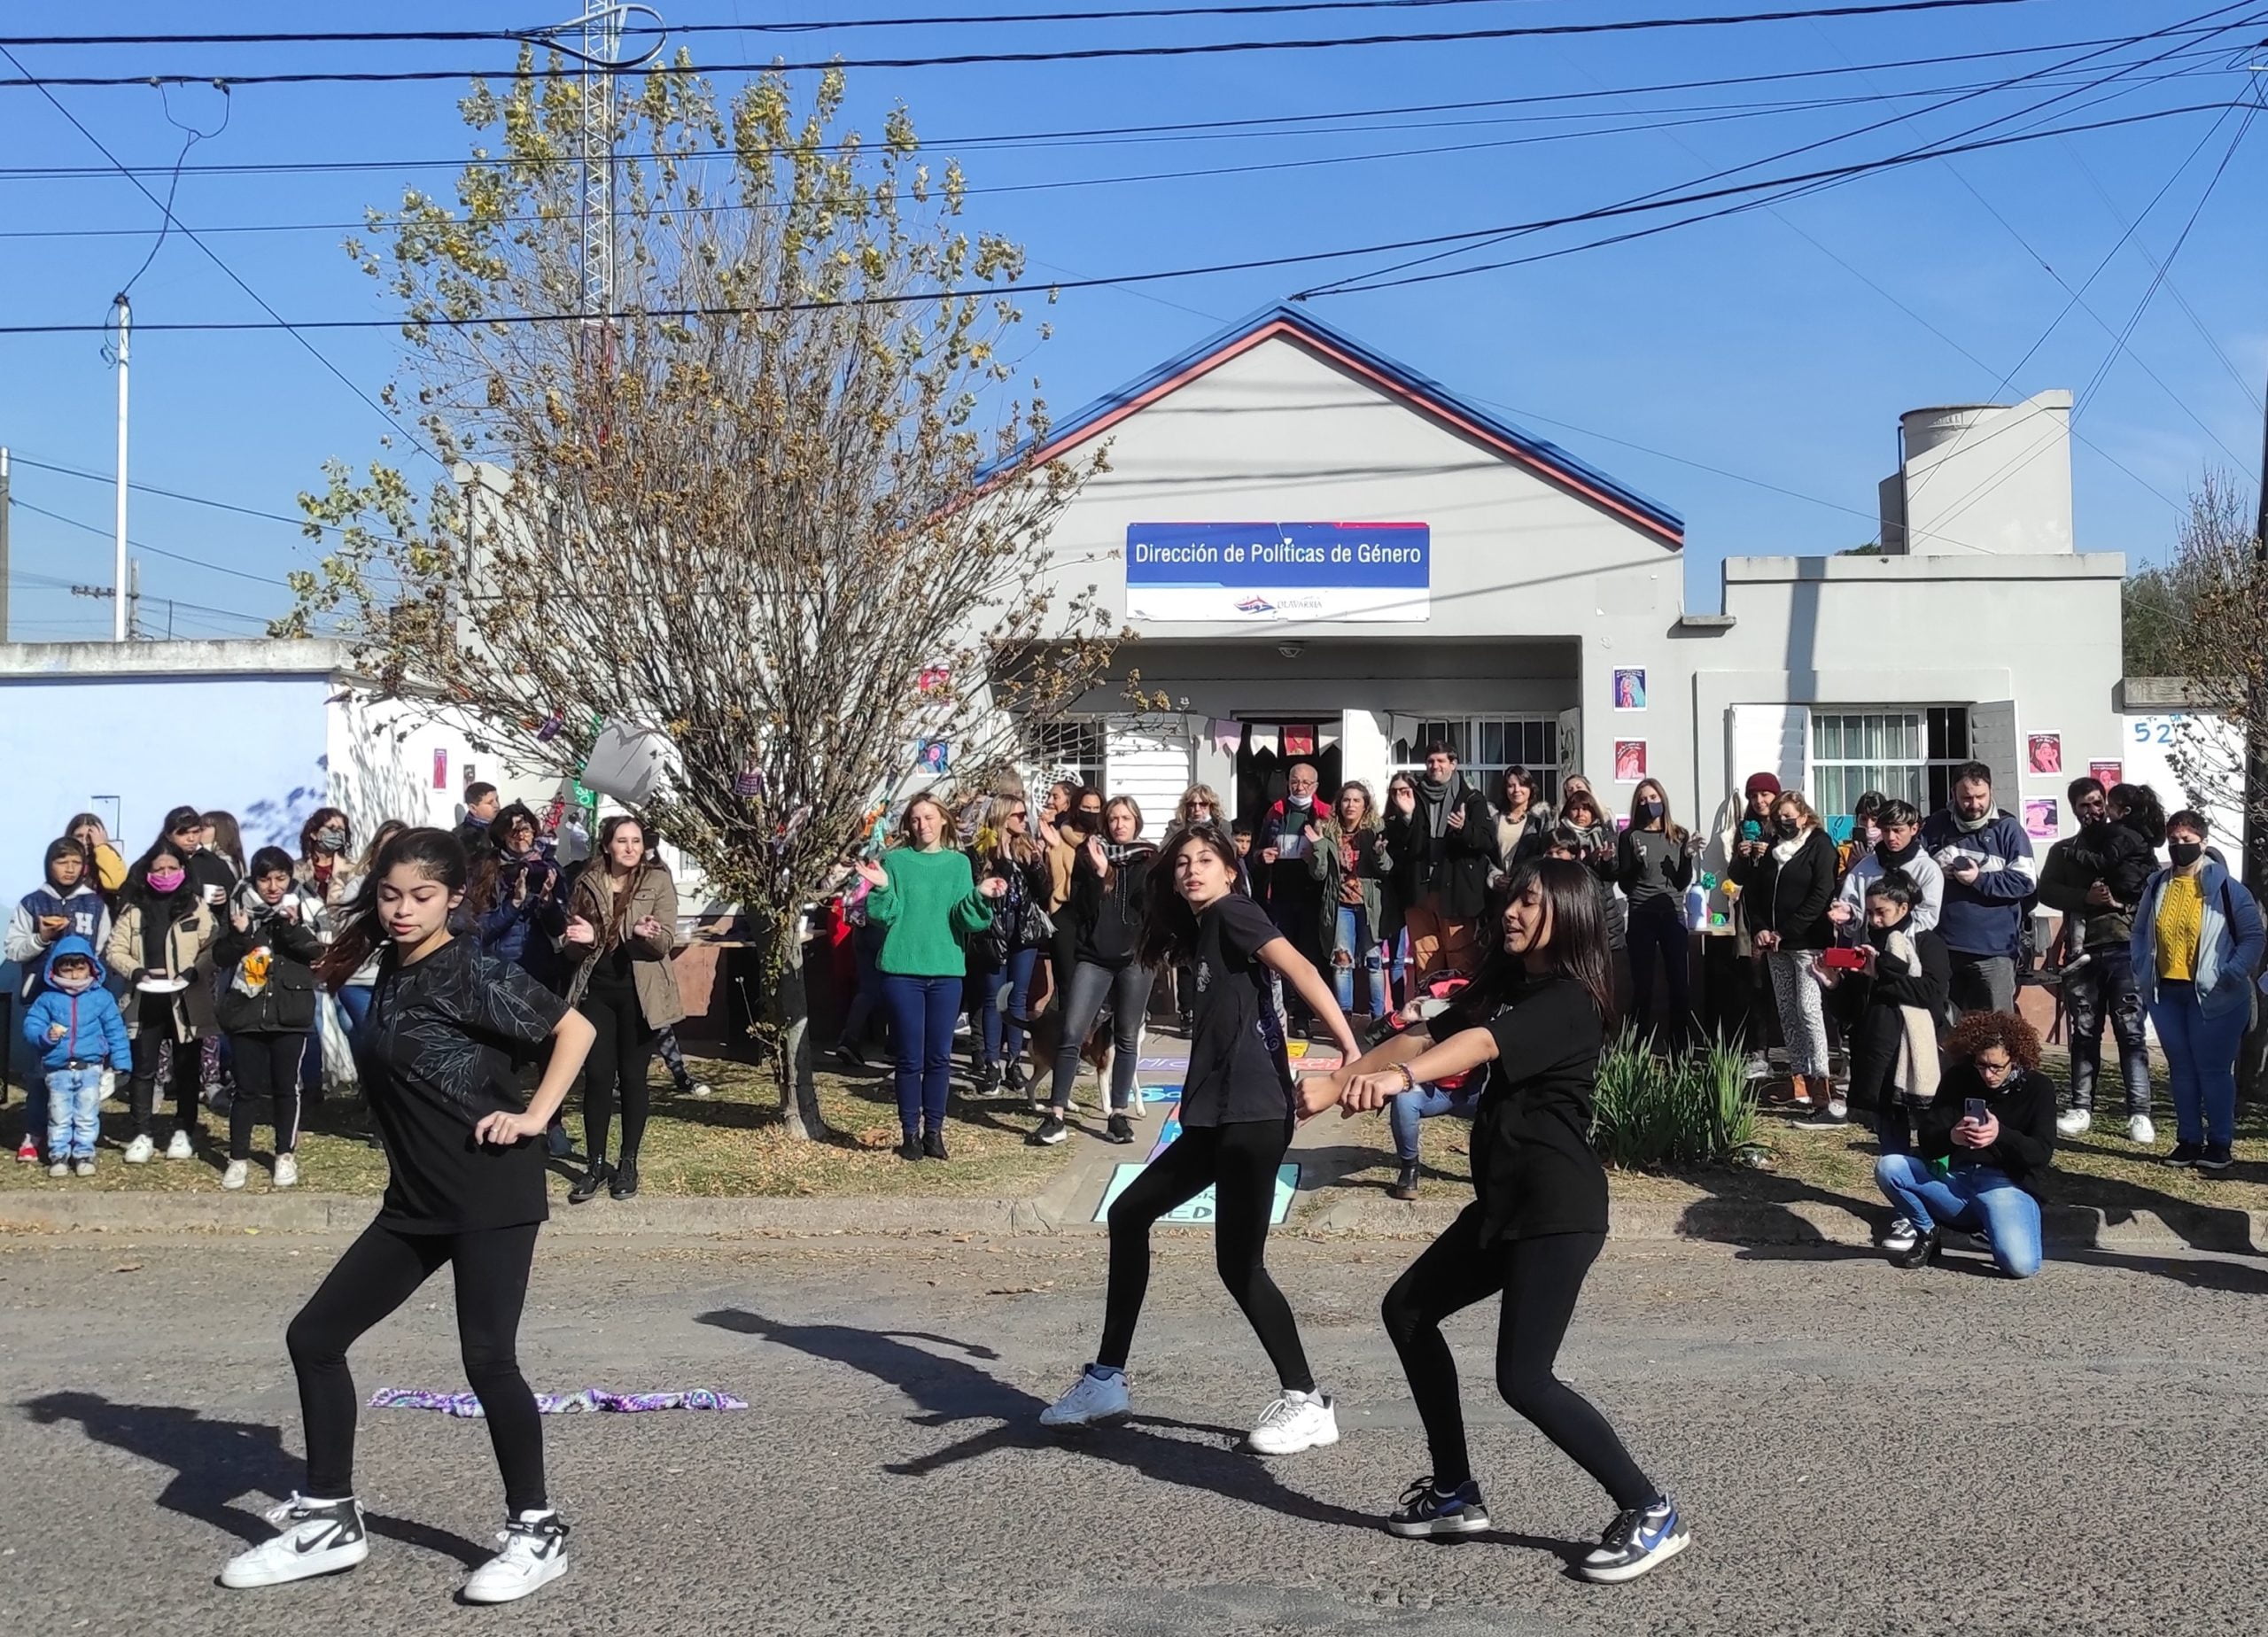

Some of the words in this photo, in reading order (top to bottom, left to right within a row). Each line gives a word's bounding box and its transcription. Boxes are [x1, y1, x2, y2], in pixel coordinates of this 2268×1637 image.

[1135, 542, 1218, 563] Dirección
[1223, 542, 1246, 563] de
[1251, 542, 1325, 563] Políticas
[1331, 542, 1352, 563] de
[1357, 542, 1422, 563] Género
[74, 912, 94, 935] H
